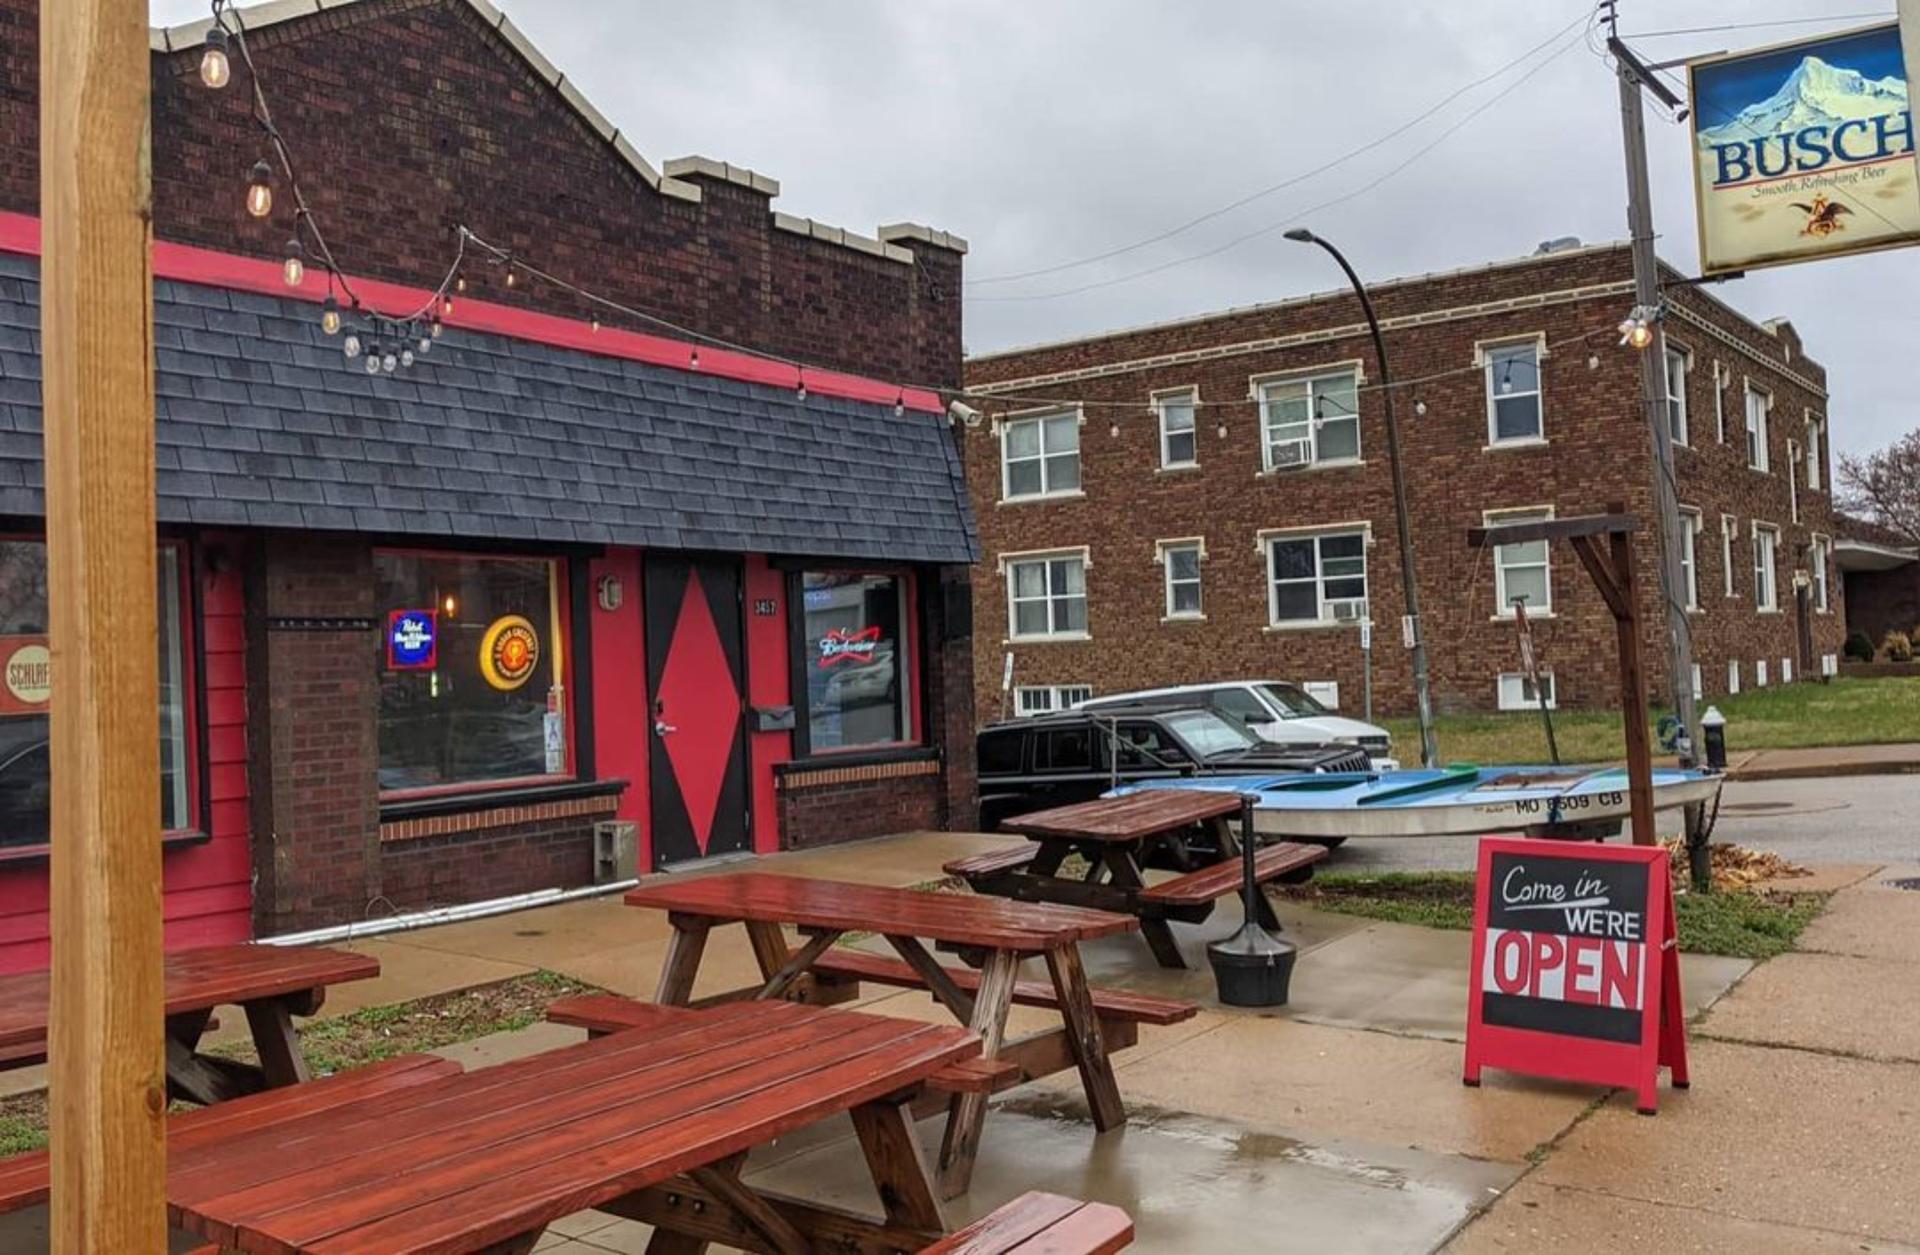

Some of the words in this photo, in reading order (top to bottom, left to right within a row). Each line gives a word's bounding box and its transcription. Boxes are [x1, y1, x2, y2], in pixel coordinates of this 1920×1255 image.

[1711, 111, 1915, 185] BUSCH
[1516, 798, 1539, 814] MO
[1598, 791, 1623, 806] CB
[1502, 865, 1566, 903] Come
[1574, 869, 1610, 898] in
[1565, 908, 1640, 938] WE'RE
[1493, 930, 1641, 1010] OPEN
